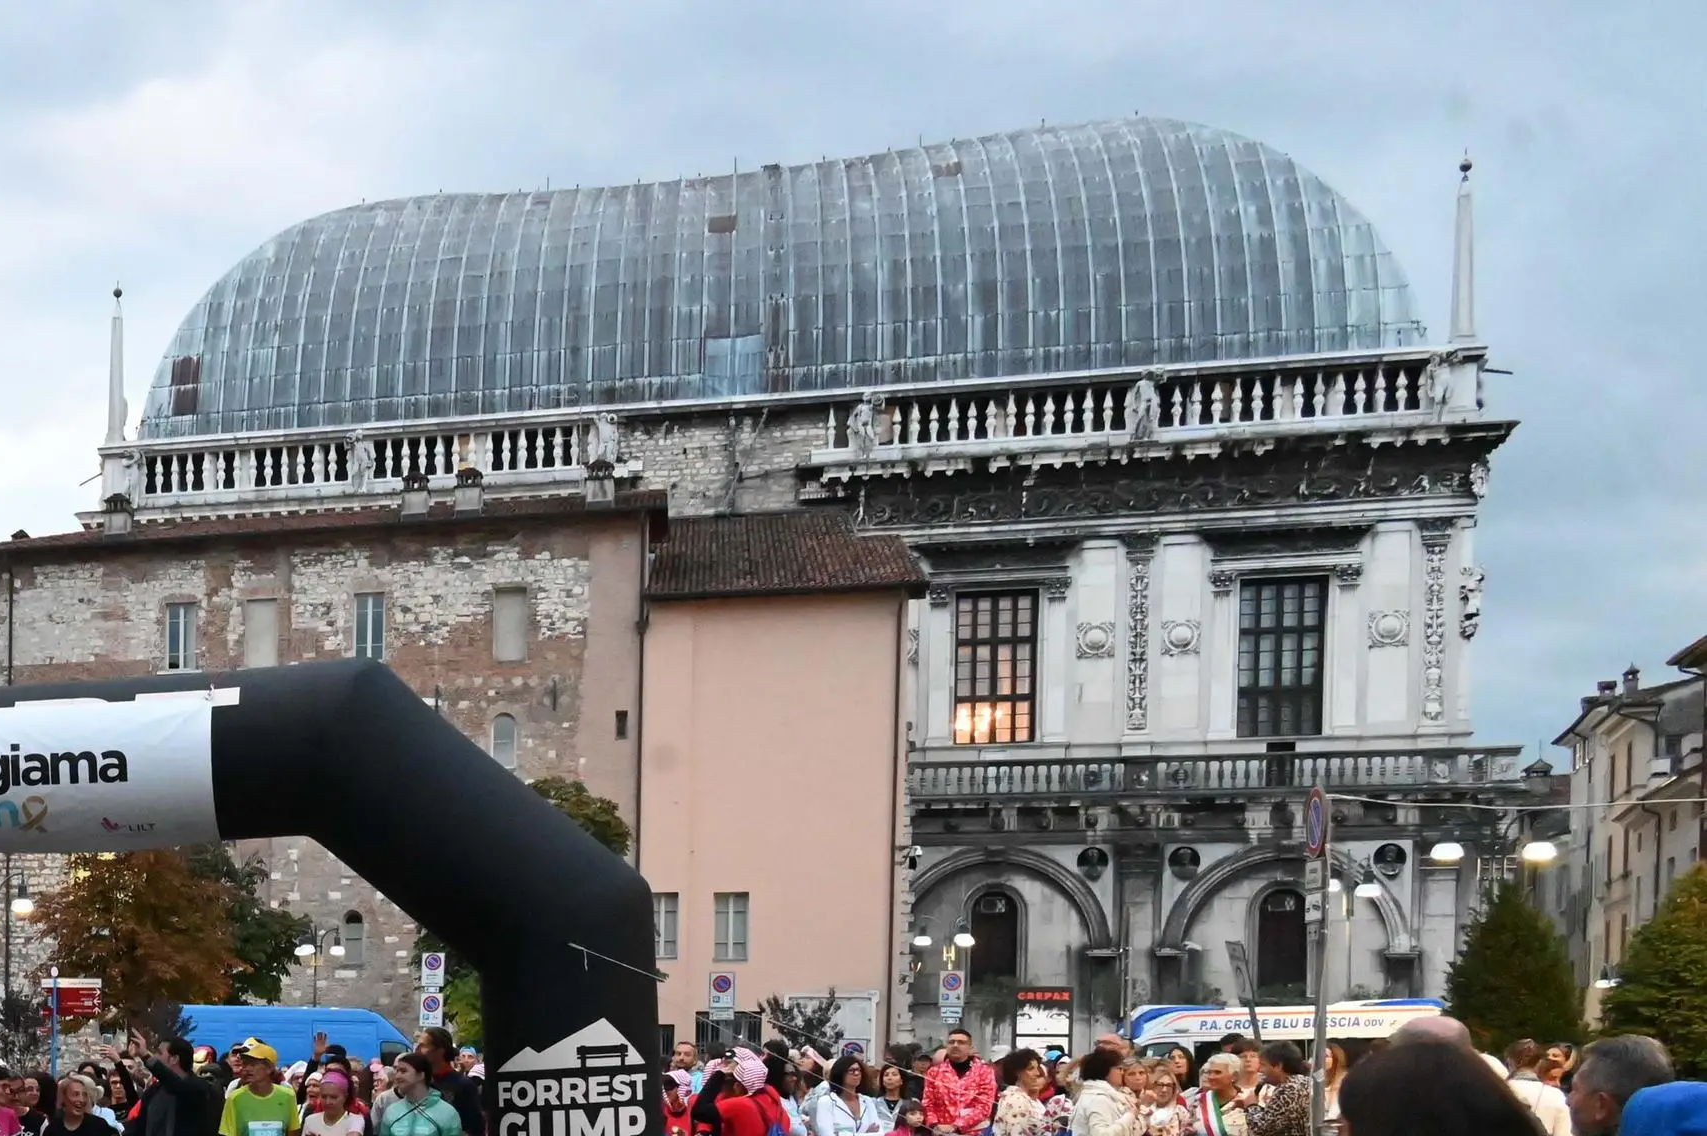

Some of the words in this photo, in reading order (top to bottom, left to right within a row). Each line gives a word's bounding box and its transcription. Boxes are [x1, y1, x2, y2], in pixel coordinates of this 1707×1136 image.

[1199, 1020, 1222, 1031] P.A.
[1273, 1018, 1299, 1029] BLU
[1364, 1018, 1384, 1028] ODV
[498, 1073, 647, 1107] FORREST
